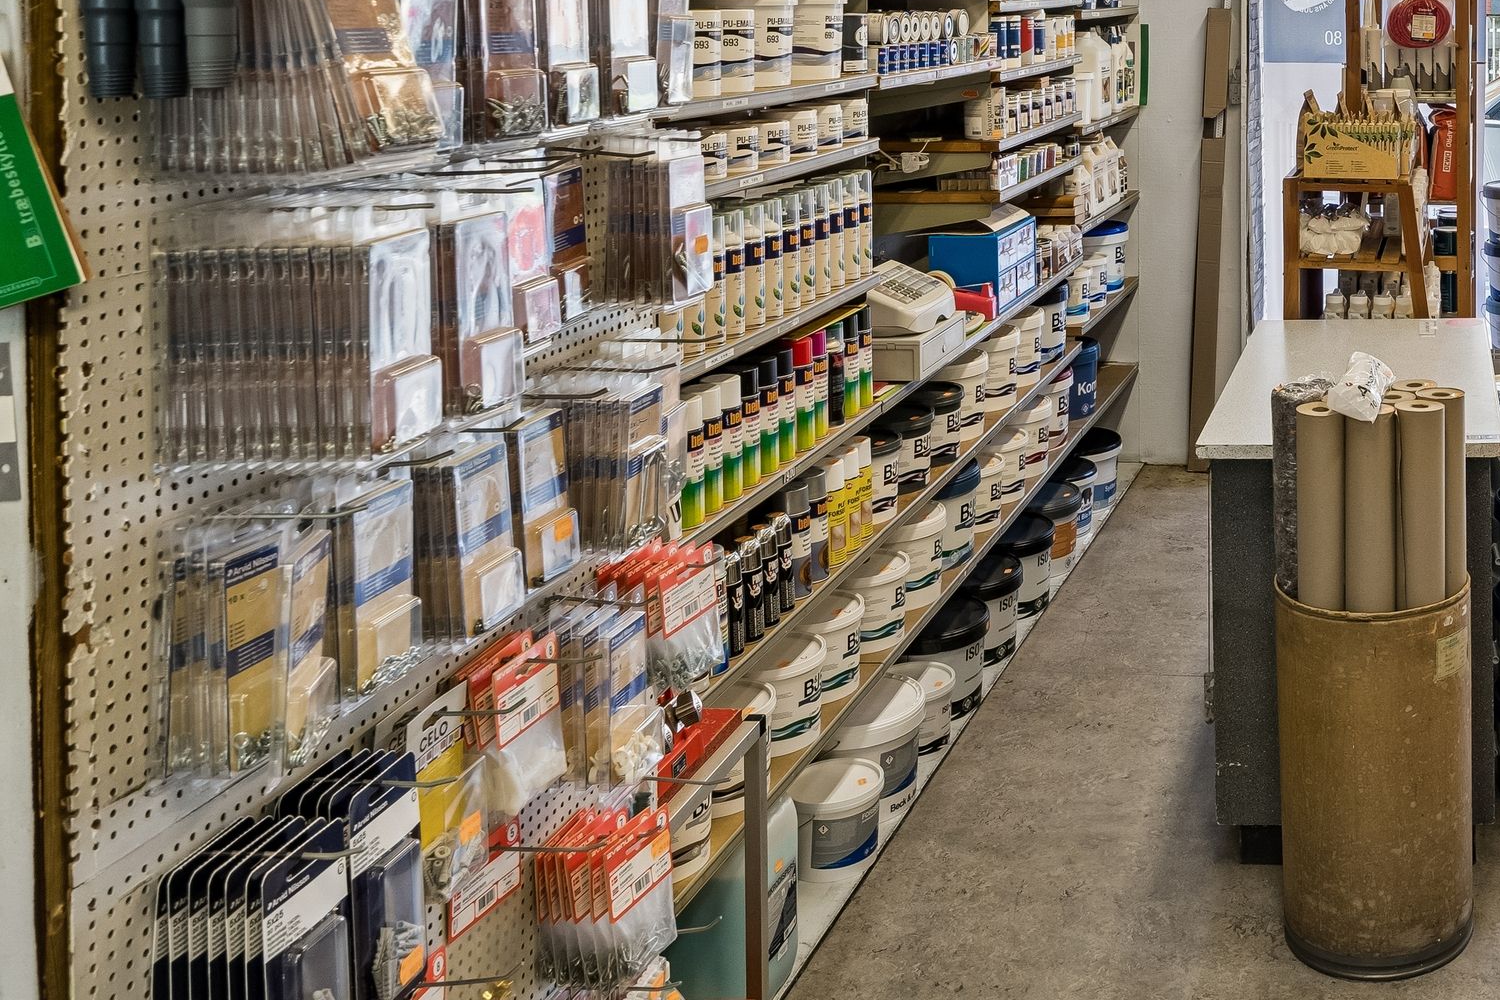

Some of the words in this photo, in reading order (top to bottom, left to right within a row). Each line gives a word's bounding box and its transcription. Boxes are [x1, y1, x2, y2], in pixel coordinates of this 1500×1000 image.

[766, 34, 779, 44] 693
[824, 31, 834, 39] 693
[694, 40, 709, 49] 693
[722, 38, 739, 47] 693
[1326, 144, 1359, 152] GreenProtect
[252, 552, 277, 568] Nilsson
[419, 720, 449, 753] CELO
[288, 874, 310, 895] Nilsson
